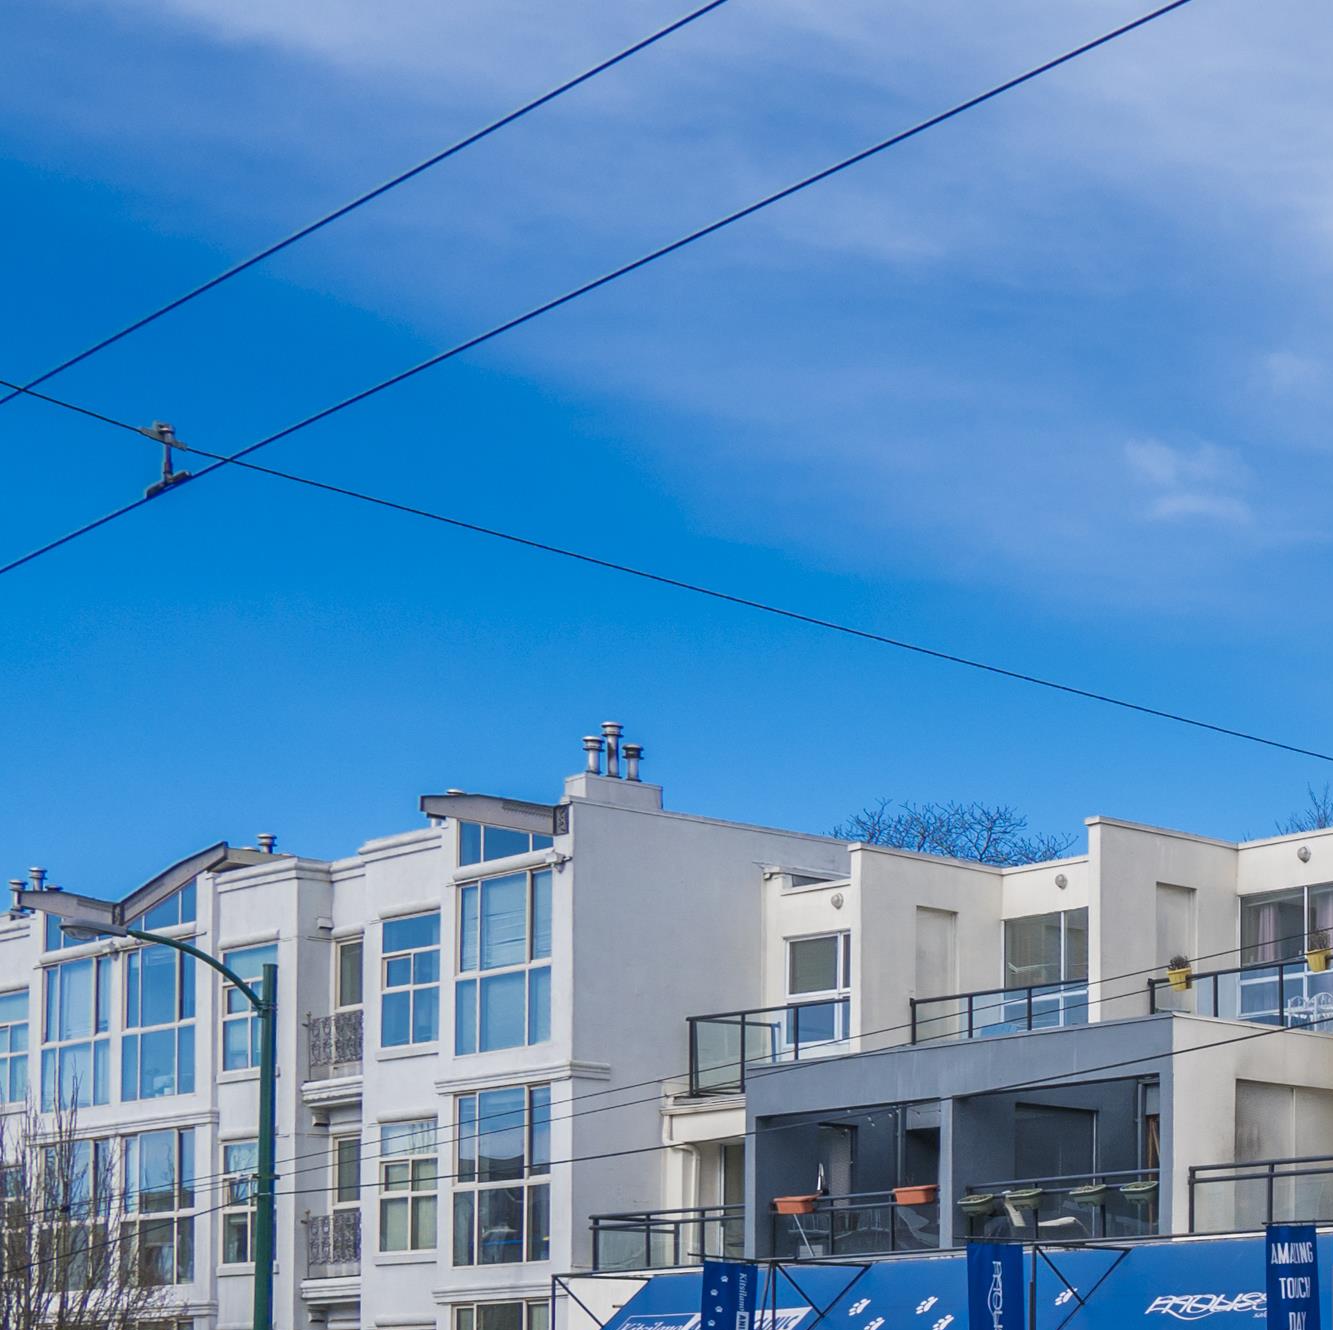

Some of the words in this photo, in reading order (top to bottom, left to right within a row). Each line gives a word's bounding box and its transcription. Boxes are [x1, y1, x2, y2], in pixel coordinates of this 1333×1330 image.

[1271, 1241, 1313, 1265] AMAZING
[738, 1272, 748, 1312] Kitsilano
[1279, 1277, 1311, 1299] TOUCH
